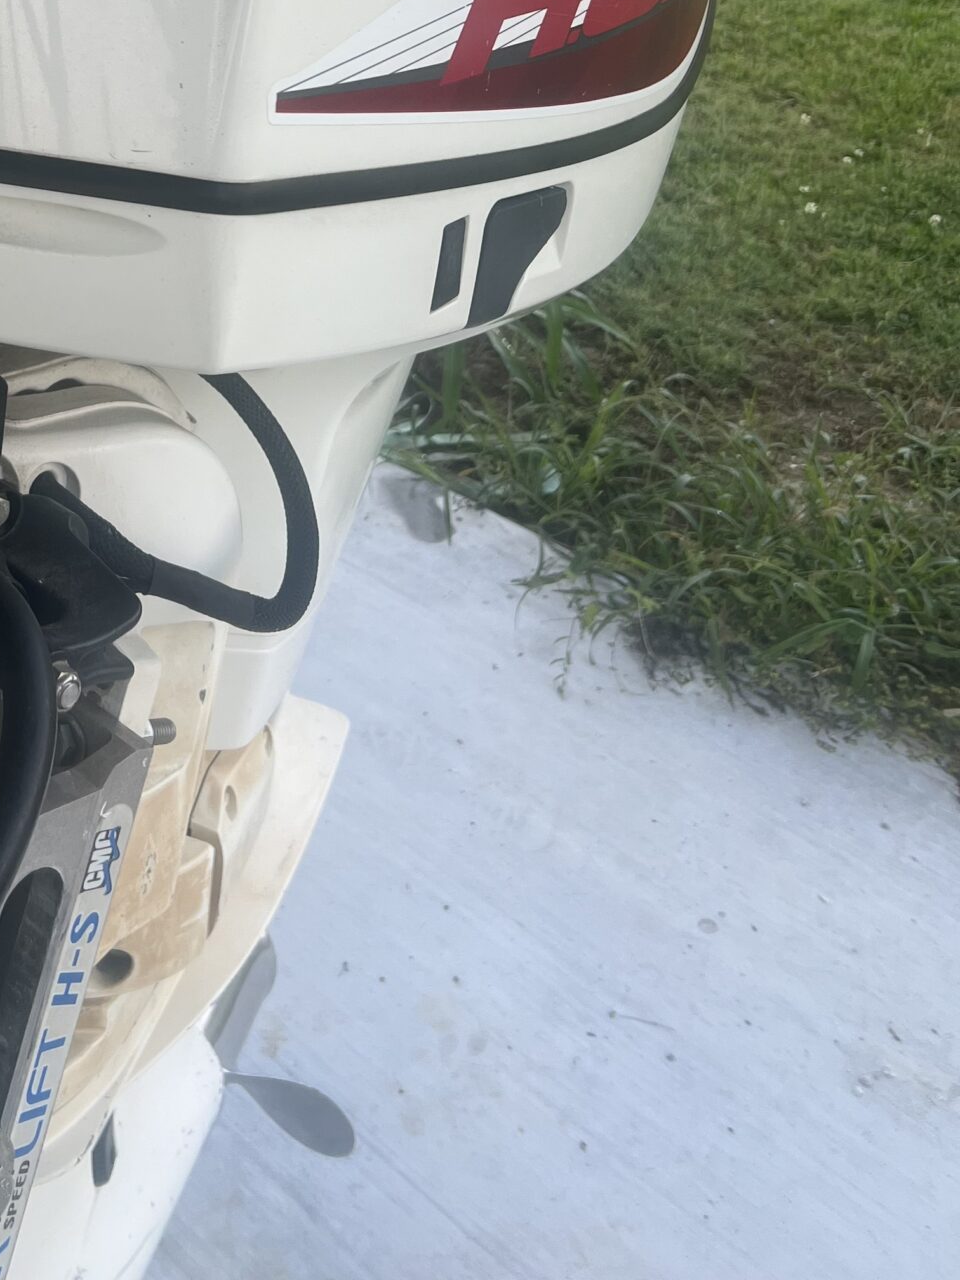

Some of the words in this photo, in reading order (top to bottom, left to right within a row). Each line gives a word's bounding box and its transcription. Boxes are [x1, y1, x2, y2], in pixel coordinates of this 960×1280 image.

[81, 827, 121, 893] CMC
[14, 1028, 67, 1160] LIFT
[3, 1159, 30, 1231] SPEED
